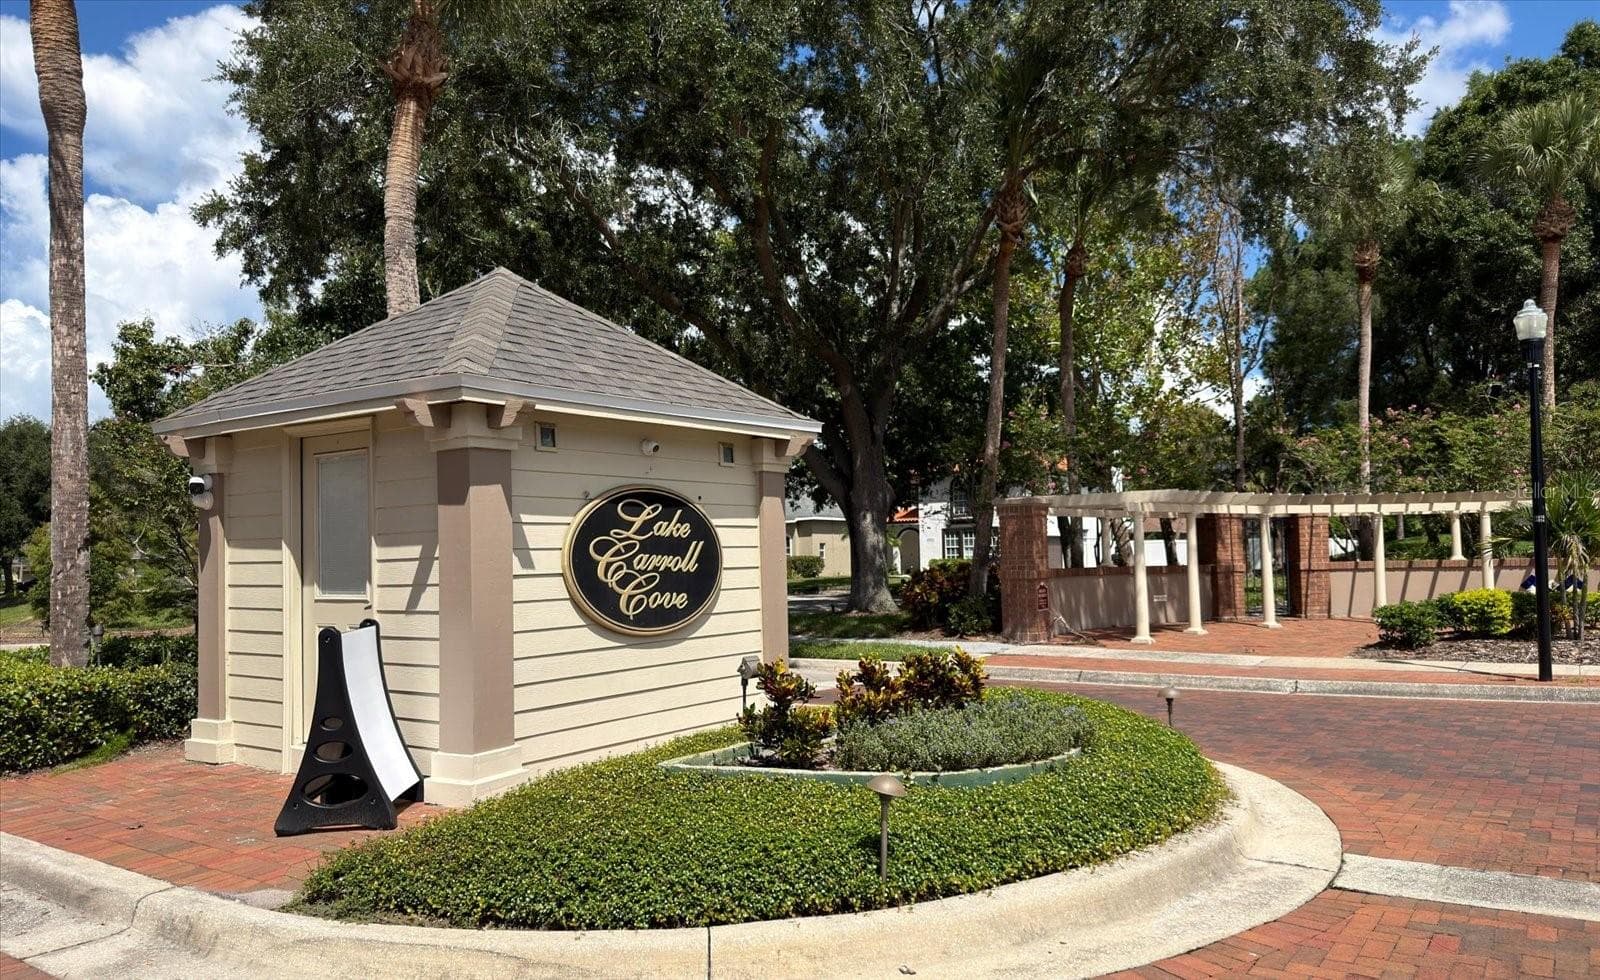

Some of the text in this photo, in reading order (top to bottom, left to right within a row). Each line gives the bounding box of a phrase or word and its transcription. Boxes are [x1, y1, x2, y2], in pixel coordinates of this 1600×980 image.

[610, 499, 691, 540] Lake
[589, 536, 704, 588] Carroll
[611, 569, 689, 620] Cove
